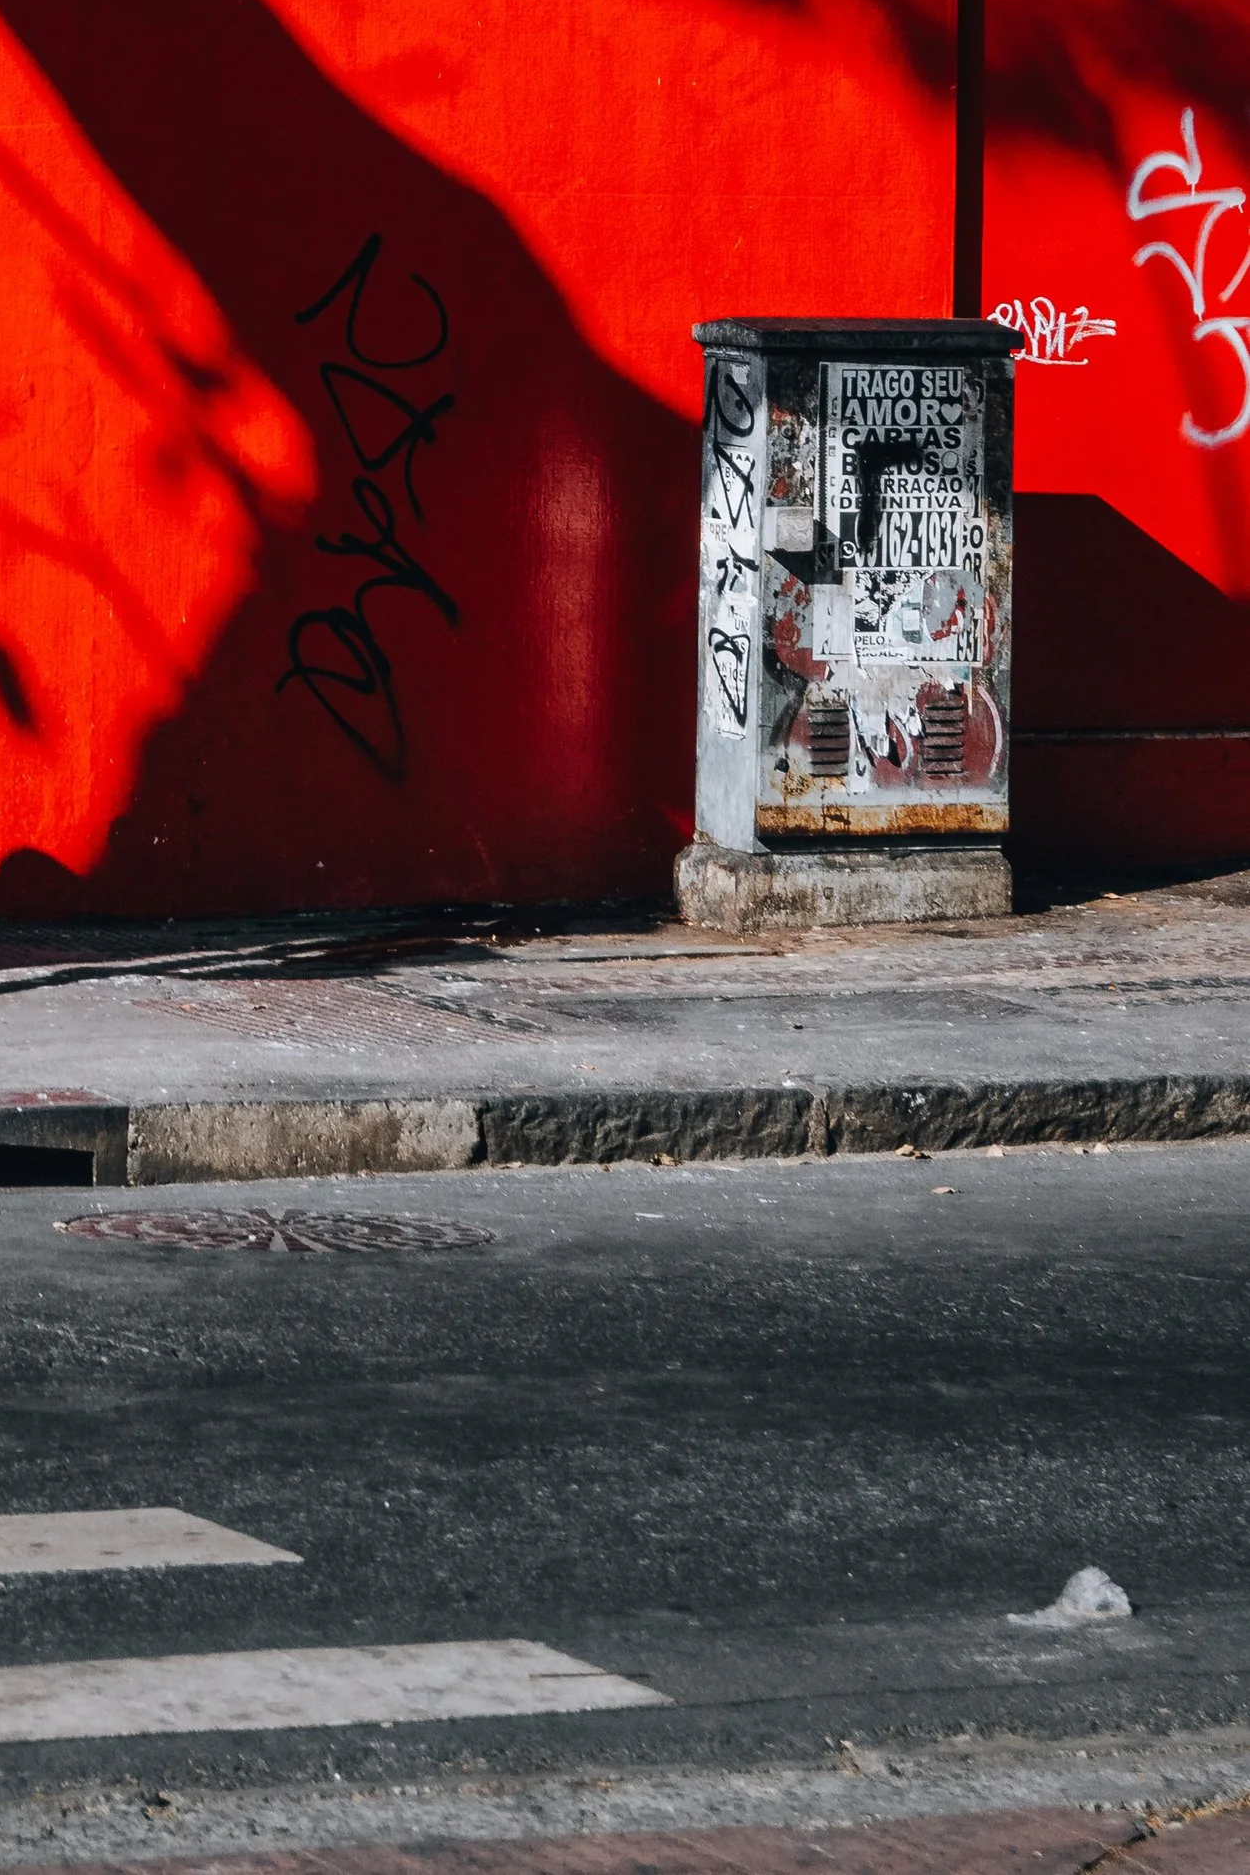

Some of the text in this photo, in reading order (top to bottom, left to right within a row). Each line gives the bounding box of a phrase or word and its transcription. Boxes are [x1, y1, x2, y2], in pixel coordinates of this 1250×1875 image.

[843, 369, 963, 398] TRAGO SEU
[844, 398, 941, 426] AMOR
[841, 427, 962, 450] CARTAS
[842, 451, 940, 476] BIOS
[840, 496, 962, 510] DEINITIVA
